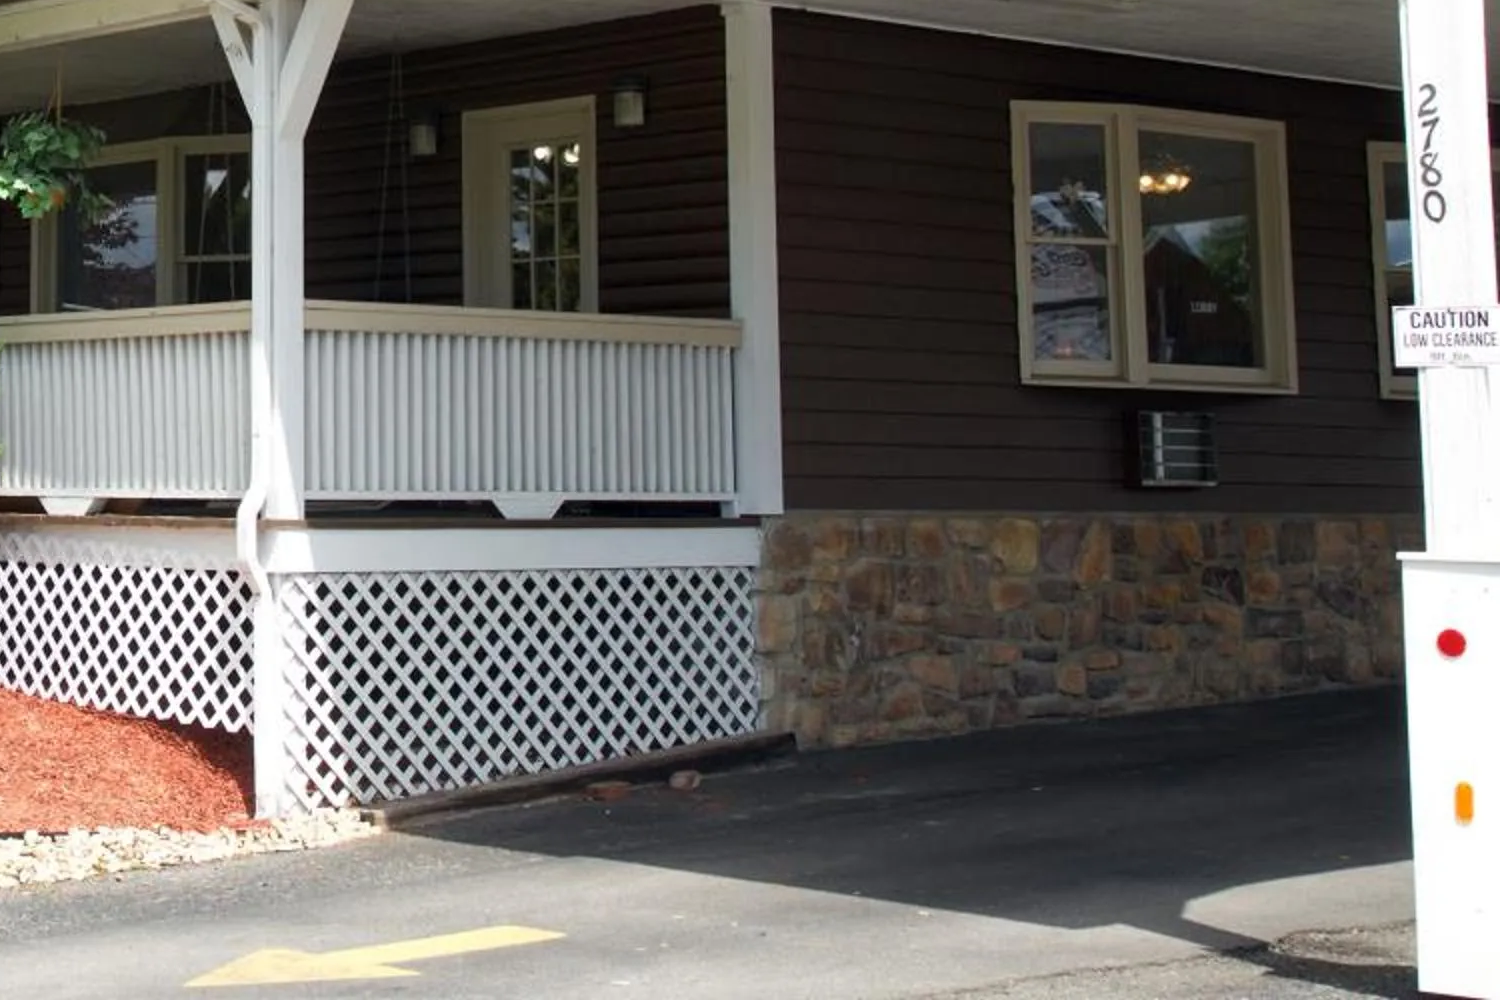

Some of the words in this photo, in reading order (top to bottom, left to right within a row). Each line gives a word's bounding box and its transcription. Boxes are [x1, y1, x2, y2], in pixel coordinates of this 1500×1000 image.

[1418, 83, 1446, 223] 2780
[1410, 310, 1489, 328] CAUTION
[1403, 334, 1429, 348] LOW
[1431, 331, 1498, 347] CLEARANCE
